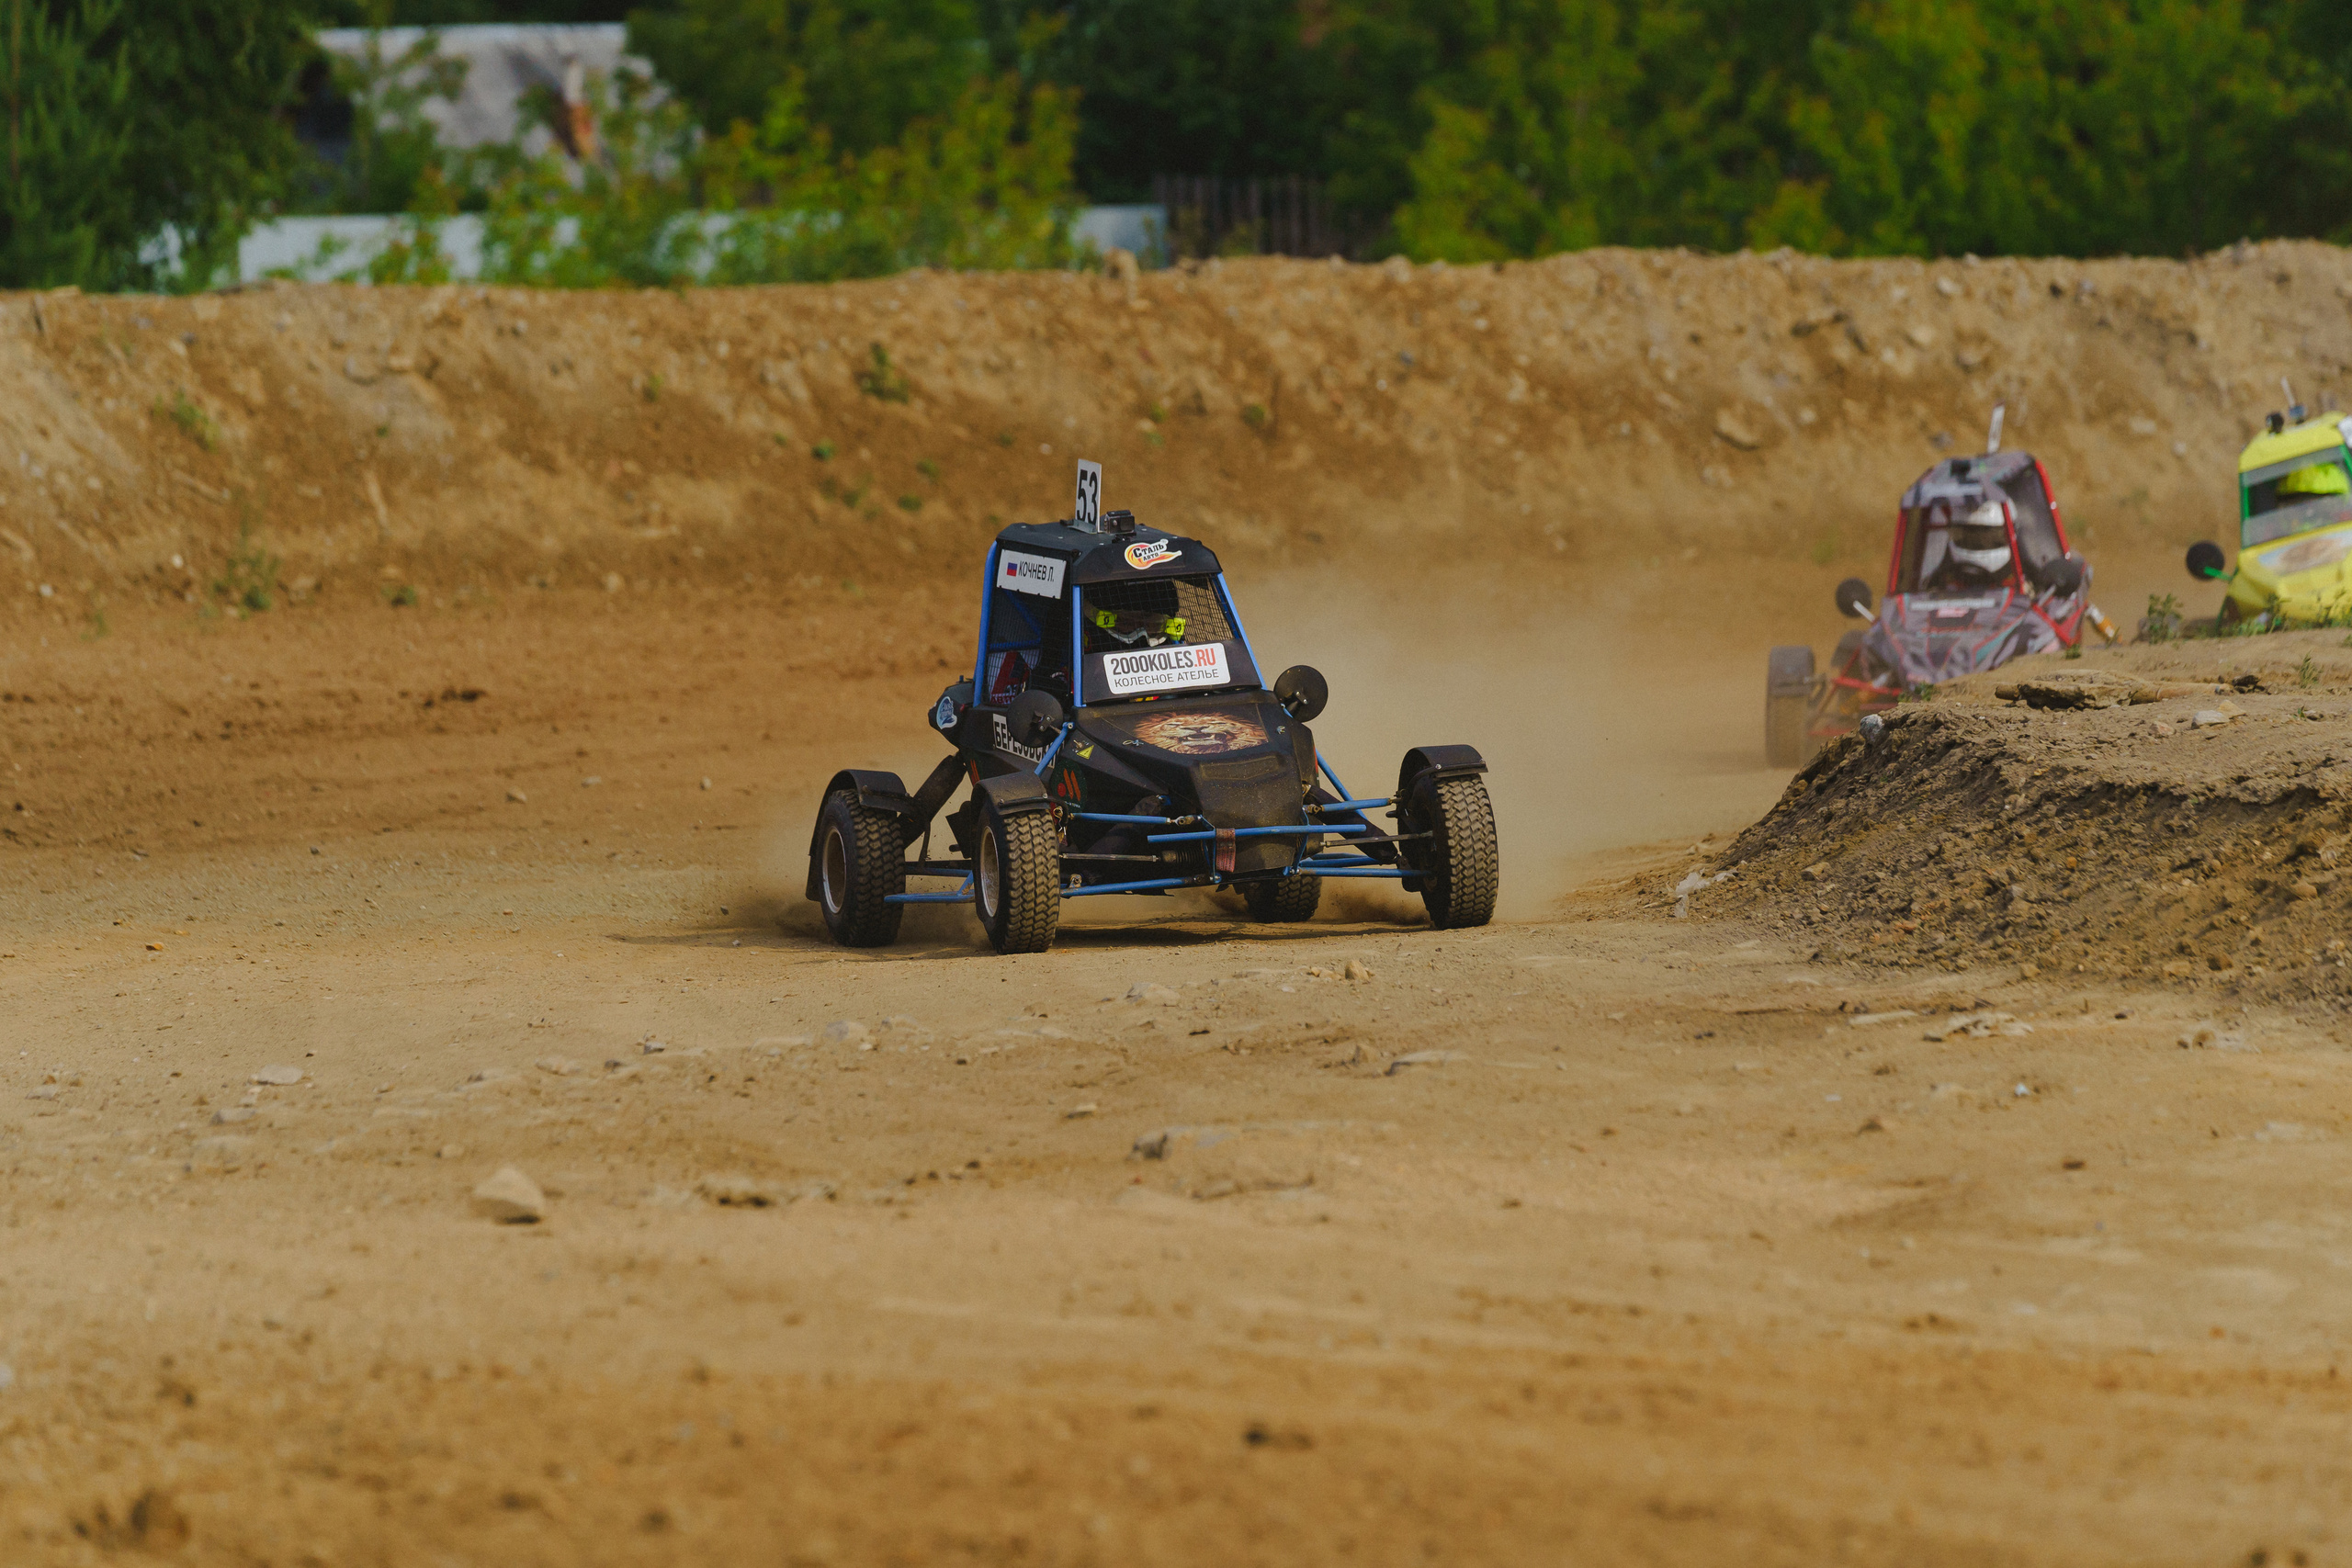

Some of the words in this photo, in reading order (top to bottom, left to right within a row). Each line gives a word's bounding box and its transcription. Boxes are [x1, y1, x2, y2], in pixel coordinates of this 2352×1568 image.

[1076, 469, 1098, 525] 53
[1143, 552, 1159, 561] АВТО
[1018, 560, 1047, 581] КОЧНЕВ
[1047, 567, 1055, 582] Л.
[1111, 648, 1216, 675] 2000KOLES.RU
[1114, 672, 1174, 688] КОЛЕСНОЕ
[1177, 669, 1219, 682] АТЕЛЬЕ
